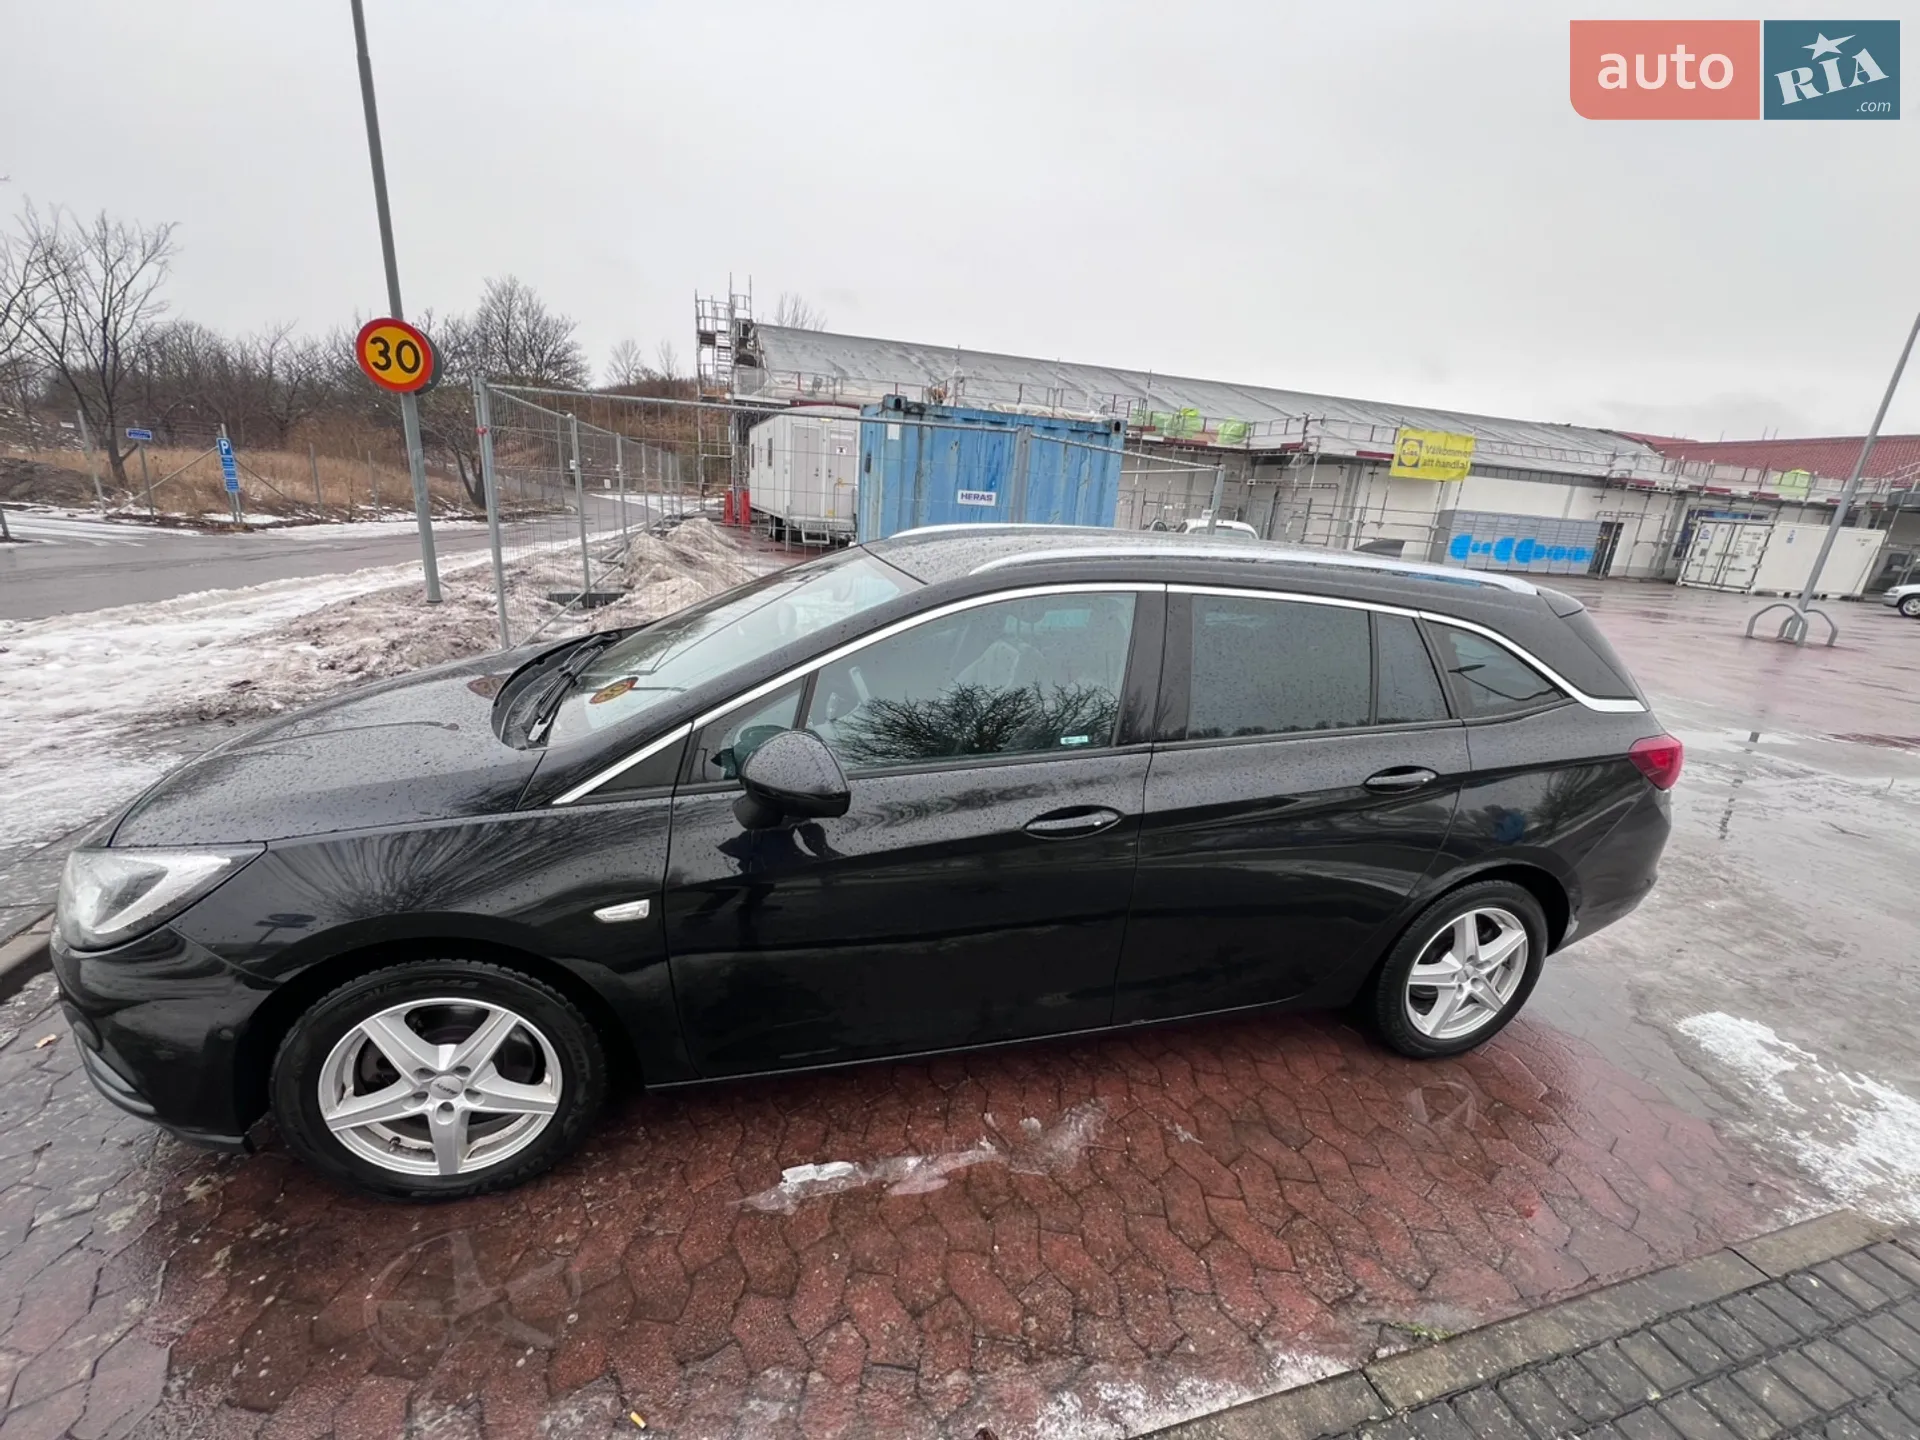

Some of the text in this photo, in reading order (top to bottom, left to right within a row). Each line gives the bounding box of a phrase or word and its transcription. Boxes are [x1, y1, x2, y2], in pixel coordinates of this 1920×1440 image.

[370, 336, 420, 374] 30
[220, 440, 229, 454] P
[1423, 458, 1468, 469] att handla!
[960, 492, 993, 501] HERAS
